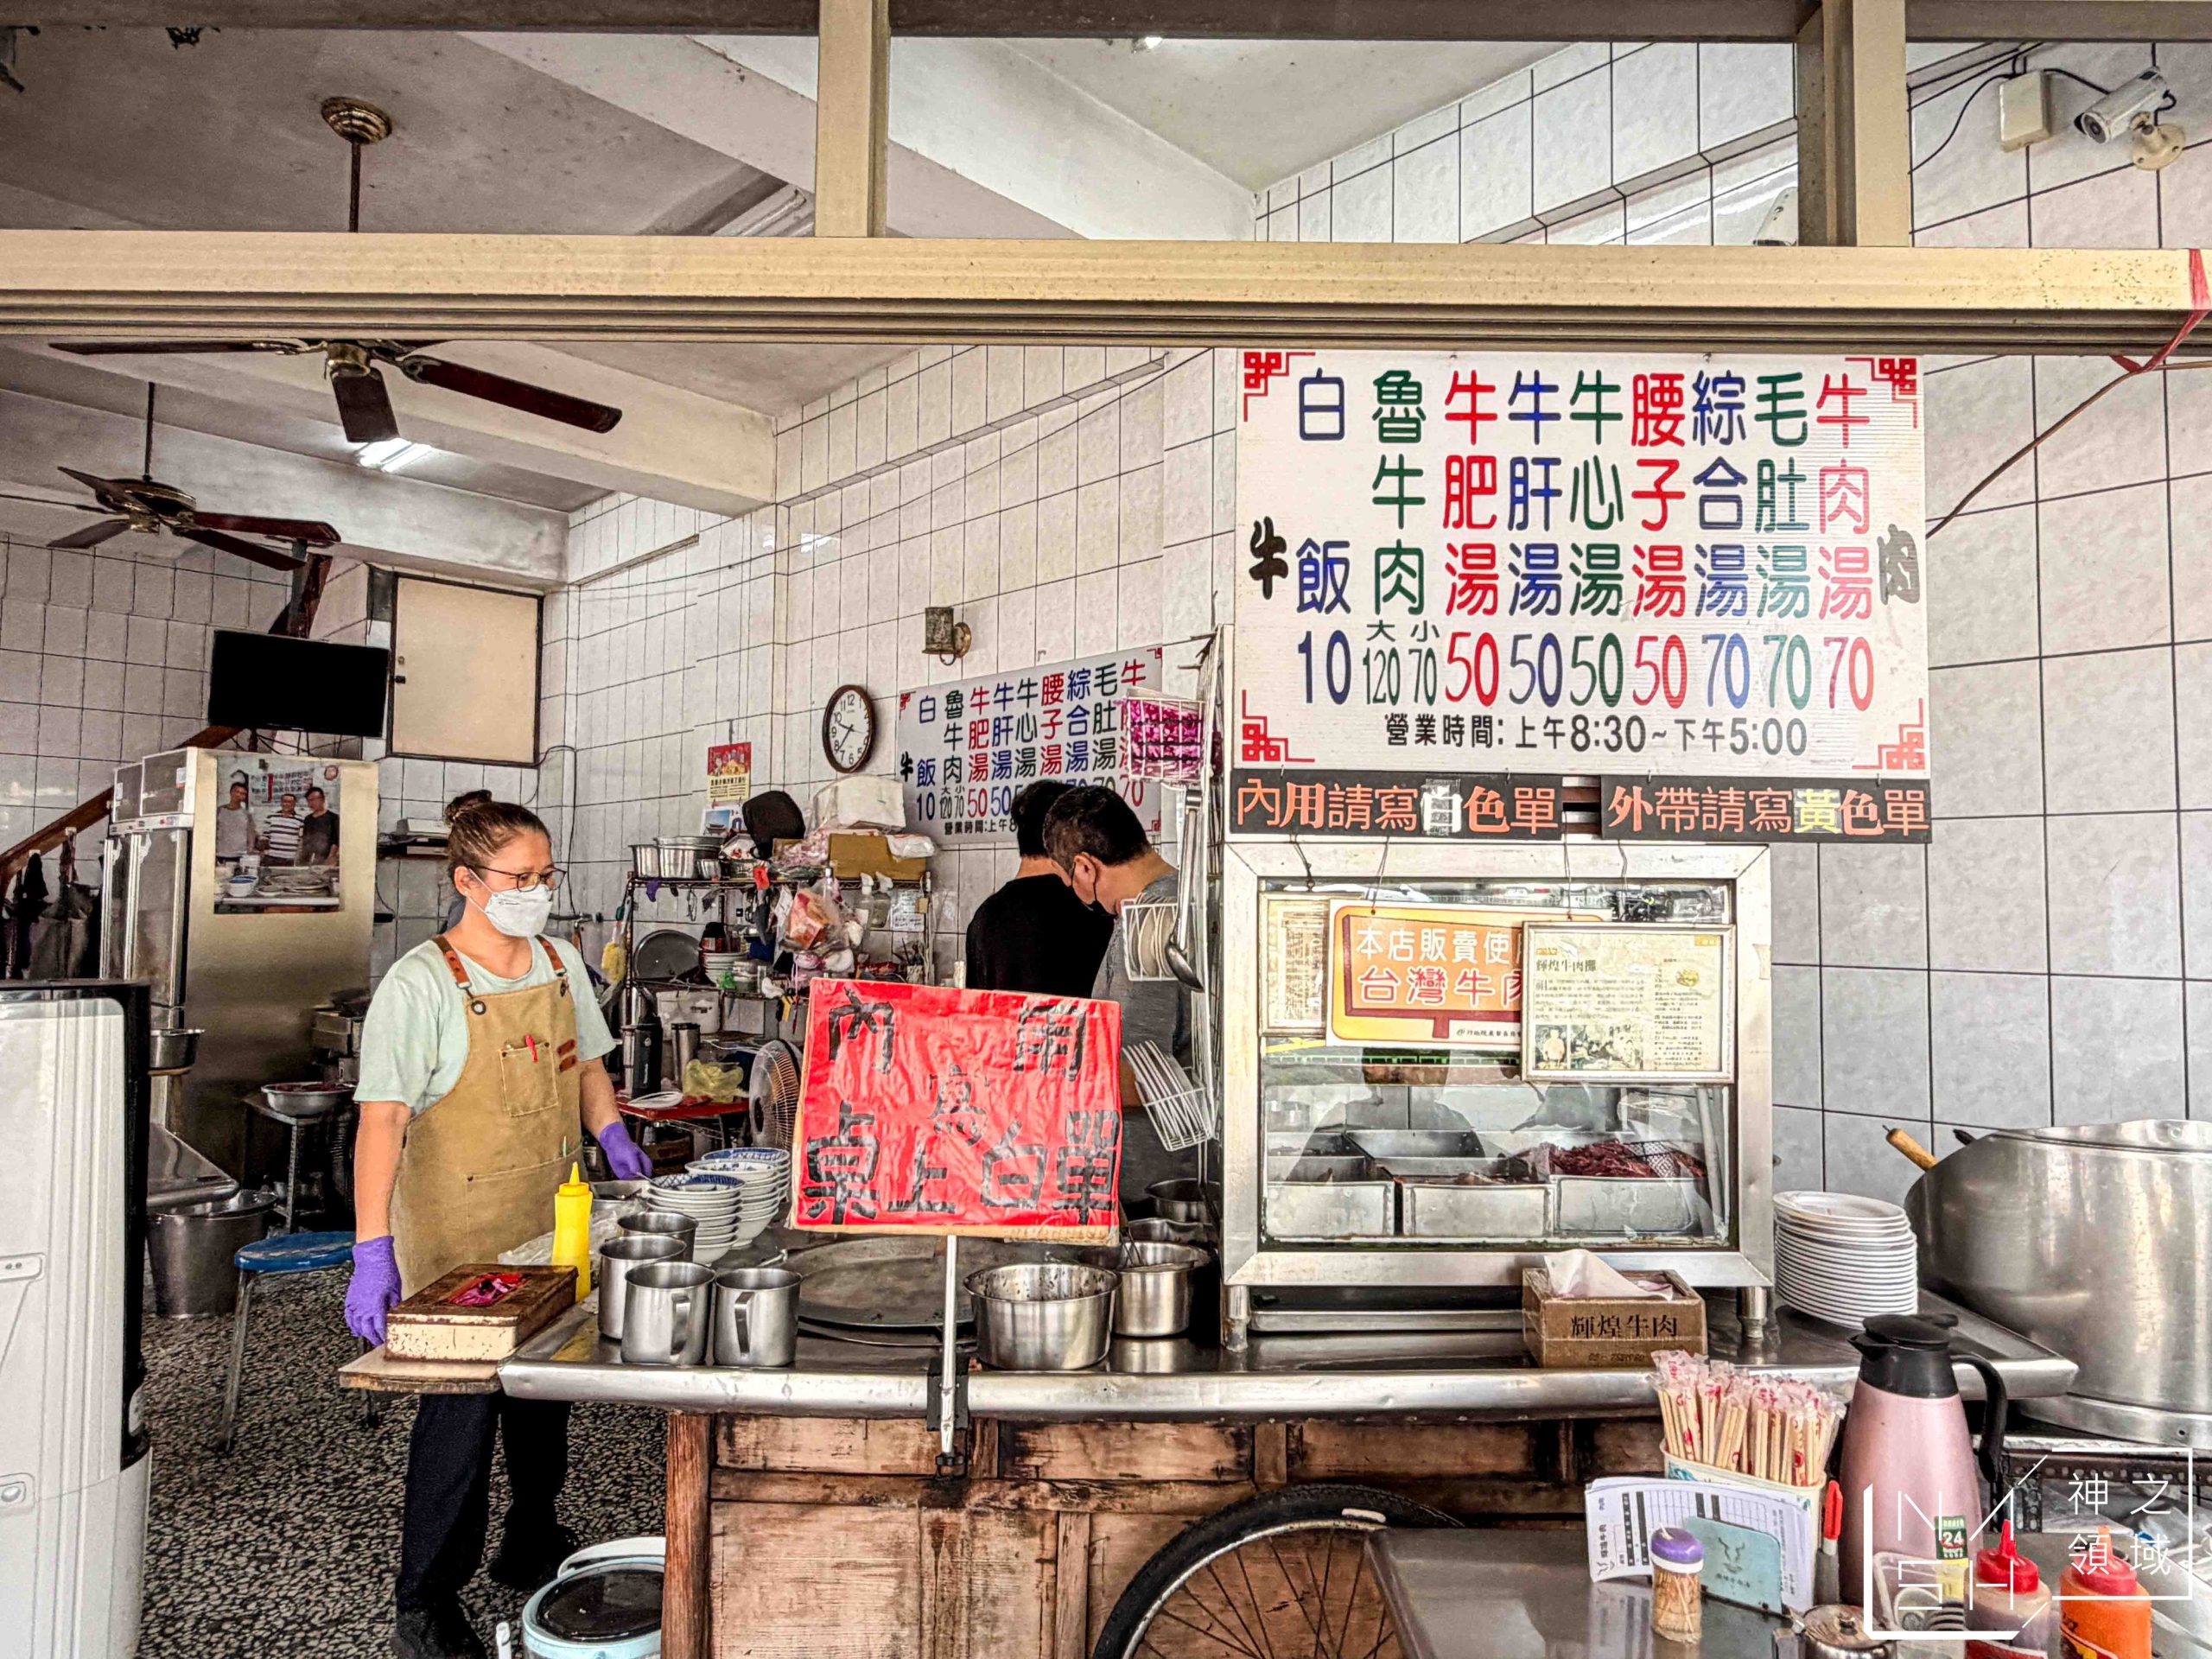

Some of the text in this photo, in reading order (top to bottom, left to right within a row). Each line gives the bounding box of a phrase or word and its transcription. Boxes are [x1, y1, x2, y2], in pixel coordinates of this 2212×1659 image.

[1372, 370, 1427, 617] 魯牛肉
[1444, 370, 1499, 618] 牛肥湯
[1508, 370, 1563, 619] 牛肝湯
[1569, 370, 1624, 619] 牛心湯
[1630, 372, 1687, 619] 腰子湯
[1692, 370, 1749, 620] 綜合湯
[1754, 370, 1810, 620] 毛肚湯
[1815, 373, 1872, 621] 牛肉湯
[1249, 515, 1288, 601] 牛
[1297, 629, 1873, 711] 10 120 70 50 50 50 50 70 70 70
[1366, 621, 1440, 643] 大 小
[944, 690, 964, 783] 魯牛肉
[968, 686, 990, 782] 牛肥湯
[992, 683, 1014, 781] 牛肝湯
[1014, 678, 1038, 778] 牛心湯
[1039, 673, 1065, 776] 腰子湯
[1065, 669, 1091, 772] 綜合湯
[1093, 663, 1117, 771] 毛肚湯
[917, 791, 935, 821] 10
[940, 796, 952, 819] 120
[955, 795, 964, 818] 70
[968, 788, 988, 818] 50
[991, 785, 1011, 816] 50
[1357, 926, 1522, 964] 本店販賣使
[1570, 1314, 1678, 1338] 輝煌牛肉
